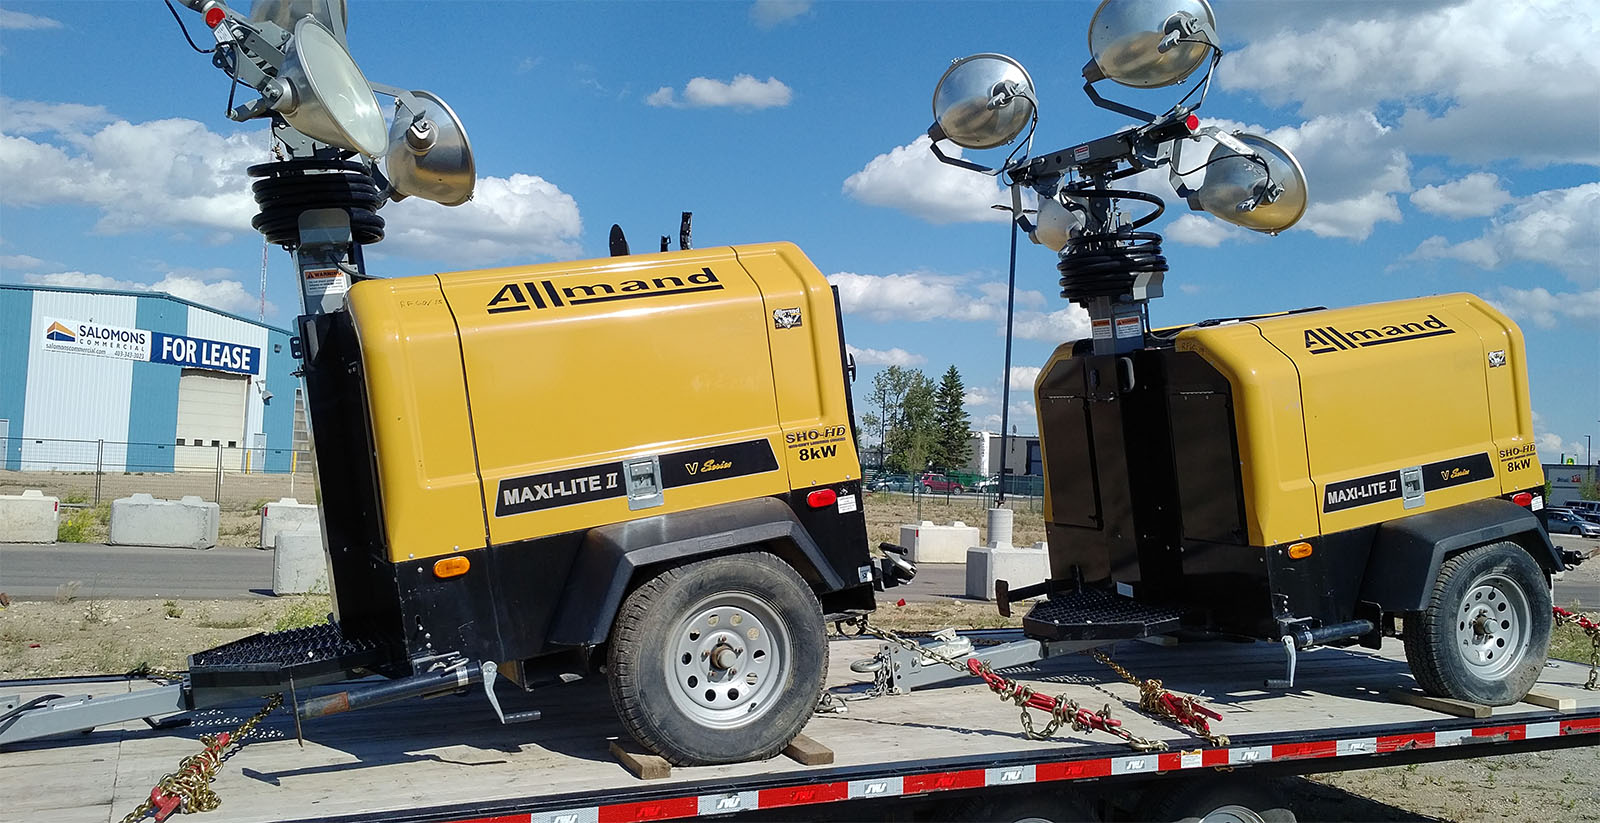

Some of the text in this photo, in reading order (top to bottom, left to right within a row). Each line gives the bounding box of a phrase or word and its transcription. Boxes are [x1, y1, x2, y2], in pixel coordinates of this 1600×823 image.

[487, 267, 724, 314] Allmand
[79, 325, 145, 345] SALOMONS
[1303, 314, 1456, 354] Allmand
[80, 338, 145, 352] COMMERCIAL
[162, 336, 251, 371] FOR LEASE
[785, 426, 846, 444] SHO-HD
[799, 444, 837, 462] 8kW
[1499, 444, 1536, 459] SHO-HD
[685, 459, 732, 475] V Series
[1507, 458, 1531, 472] 8kW
[1440, 470, 1449, 481] V
[503, 472, 618, 506] MAXI-LITE II
[1327, 479, 1397, 505] MAXI-LITE II
